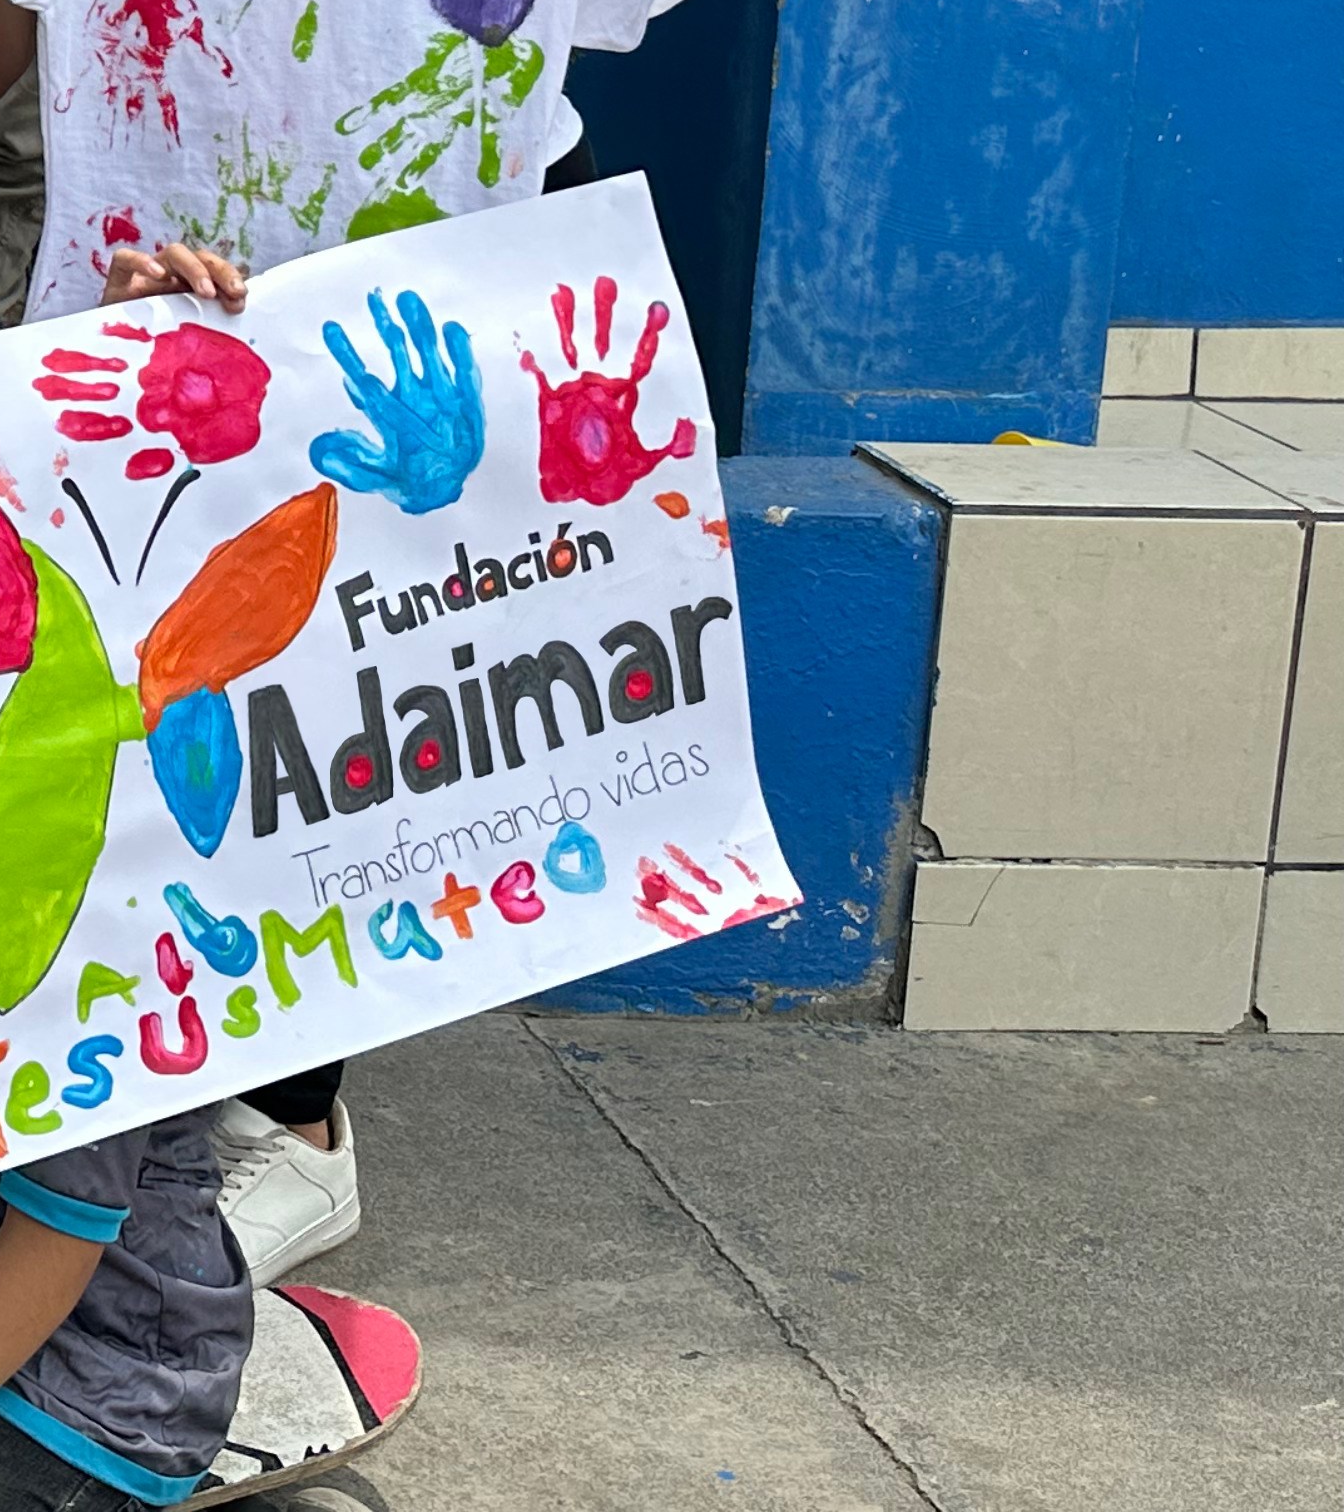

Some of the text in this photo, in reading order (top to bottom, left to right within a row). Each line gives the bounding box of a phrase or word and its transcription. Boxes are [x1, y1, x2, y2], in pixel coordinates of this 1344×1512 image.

[334, 522, 615, 652] Fundación
[247, 595, 733, 838] Adaimar
[291, 740, 710, 908] Transformando vidas
